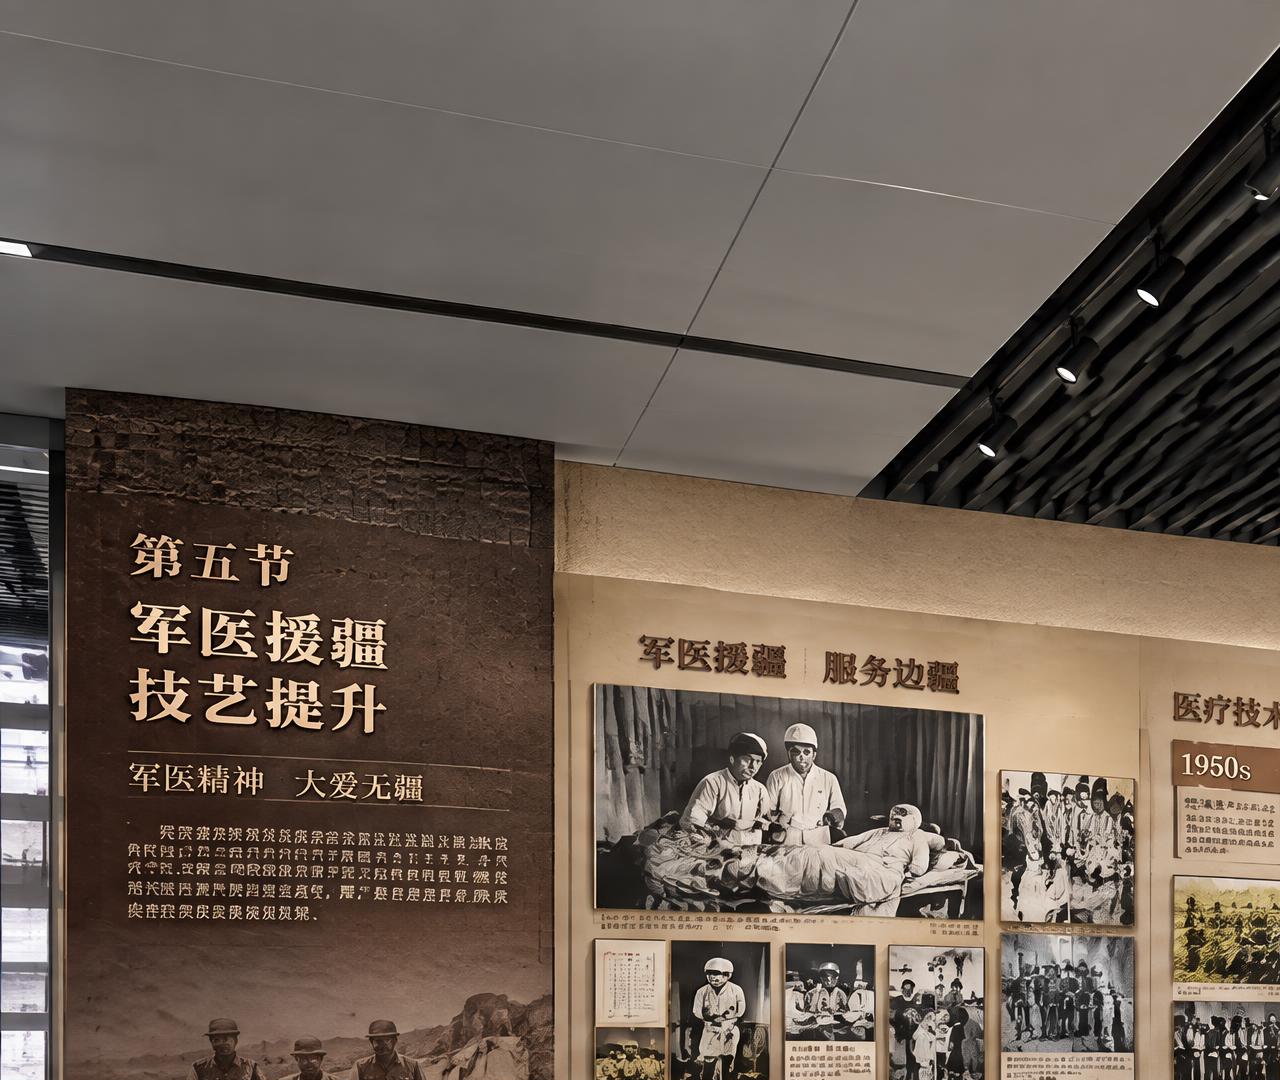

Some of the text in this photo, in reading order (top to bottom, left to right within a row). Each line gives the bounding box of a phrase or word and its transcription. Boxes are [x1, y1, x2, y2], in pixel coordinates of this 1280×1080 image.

[129, 532, 295, 587] 第五节
[129, 601, 389, 671] 军医援疆
[639, 634, 960, 695] 军医援疆 服务边疆
[128, 667, 388, 734] 技艺提升
[128, 762, 424, 802] 军医精神 大爱无疆
[1181, 753, 1252, 781] 1950s
